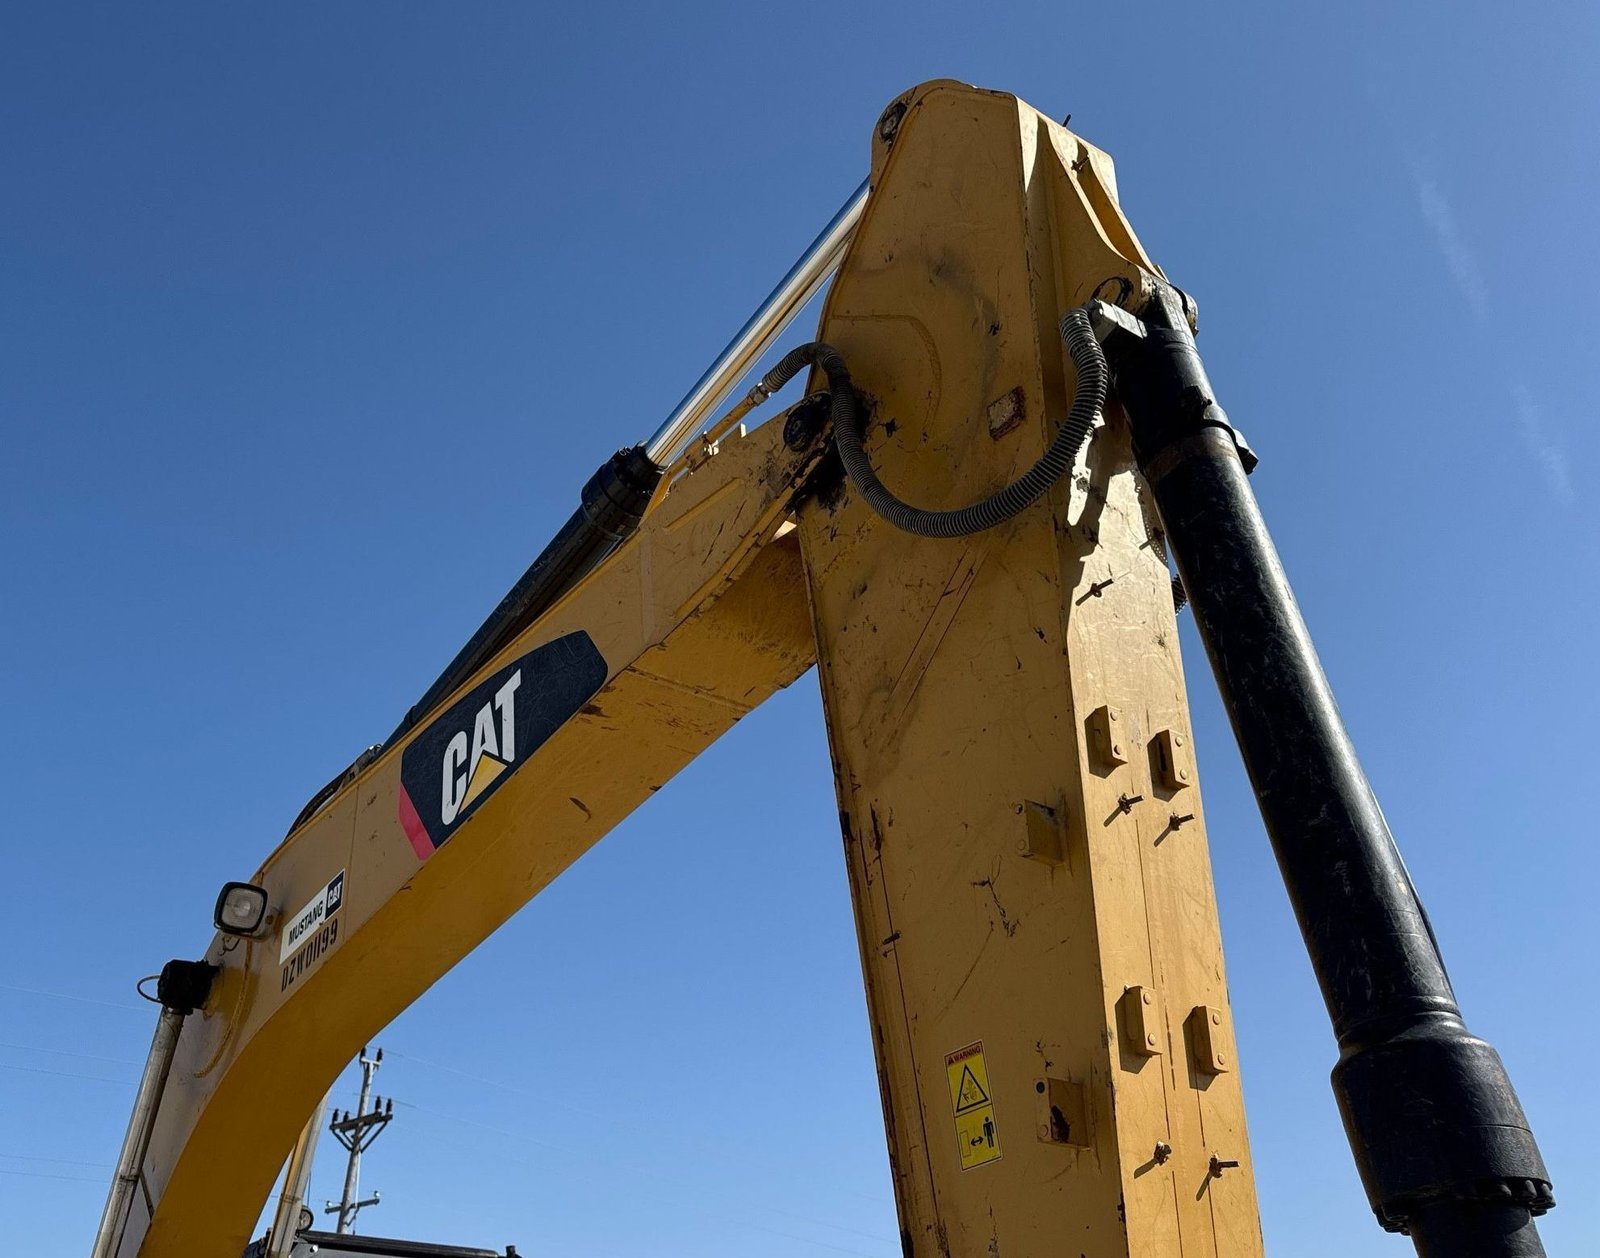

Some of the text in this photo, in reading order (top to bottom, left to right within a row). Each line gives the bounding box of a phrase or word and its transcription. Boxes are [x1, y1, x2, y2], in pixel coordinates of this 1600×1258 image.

[441, 668, 521, 826] CAT
[288, 881, 342, 947] MUSTANG CAT
[953, 1045, 981, 1061] WARNING
